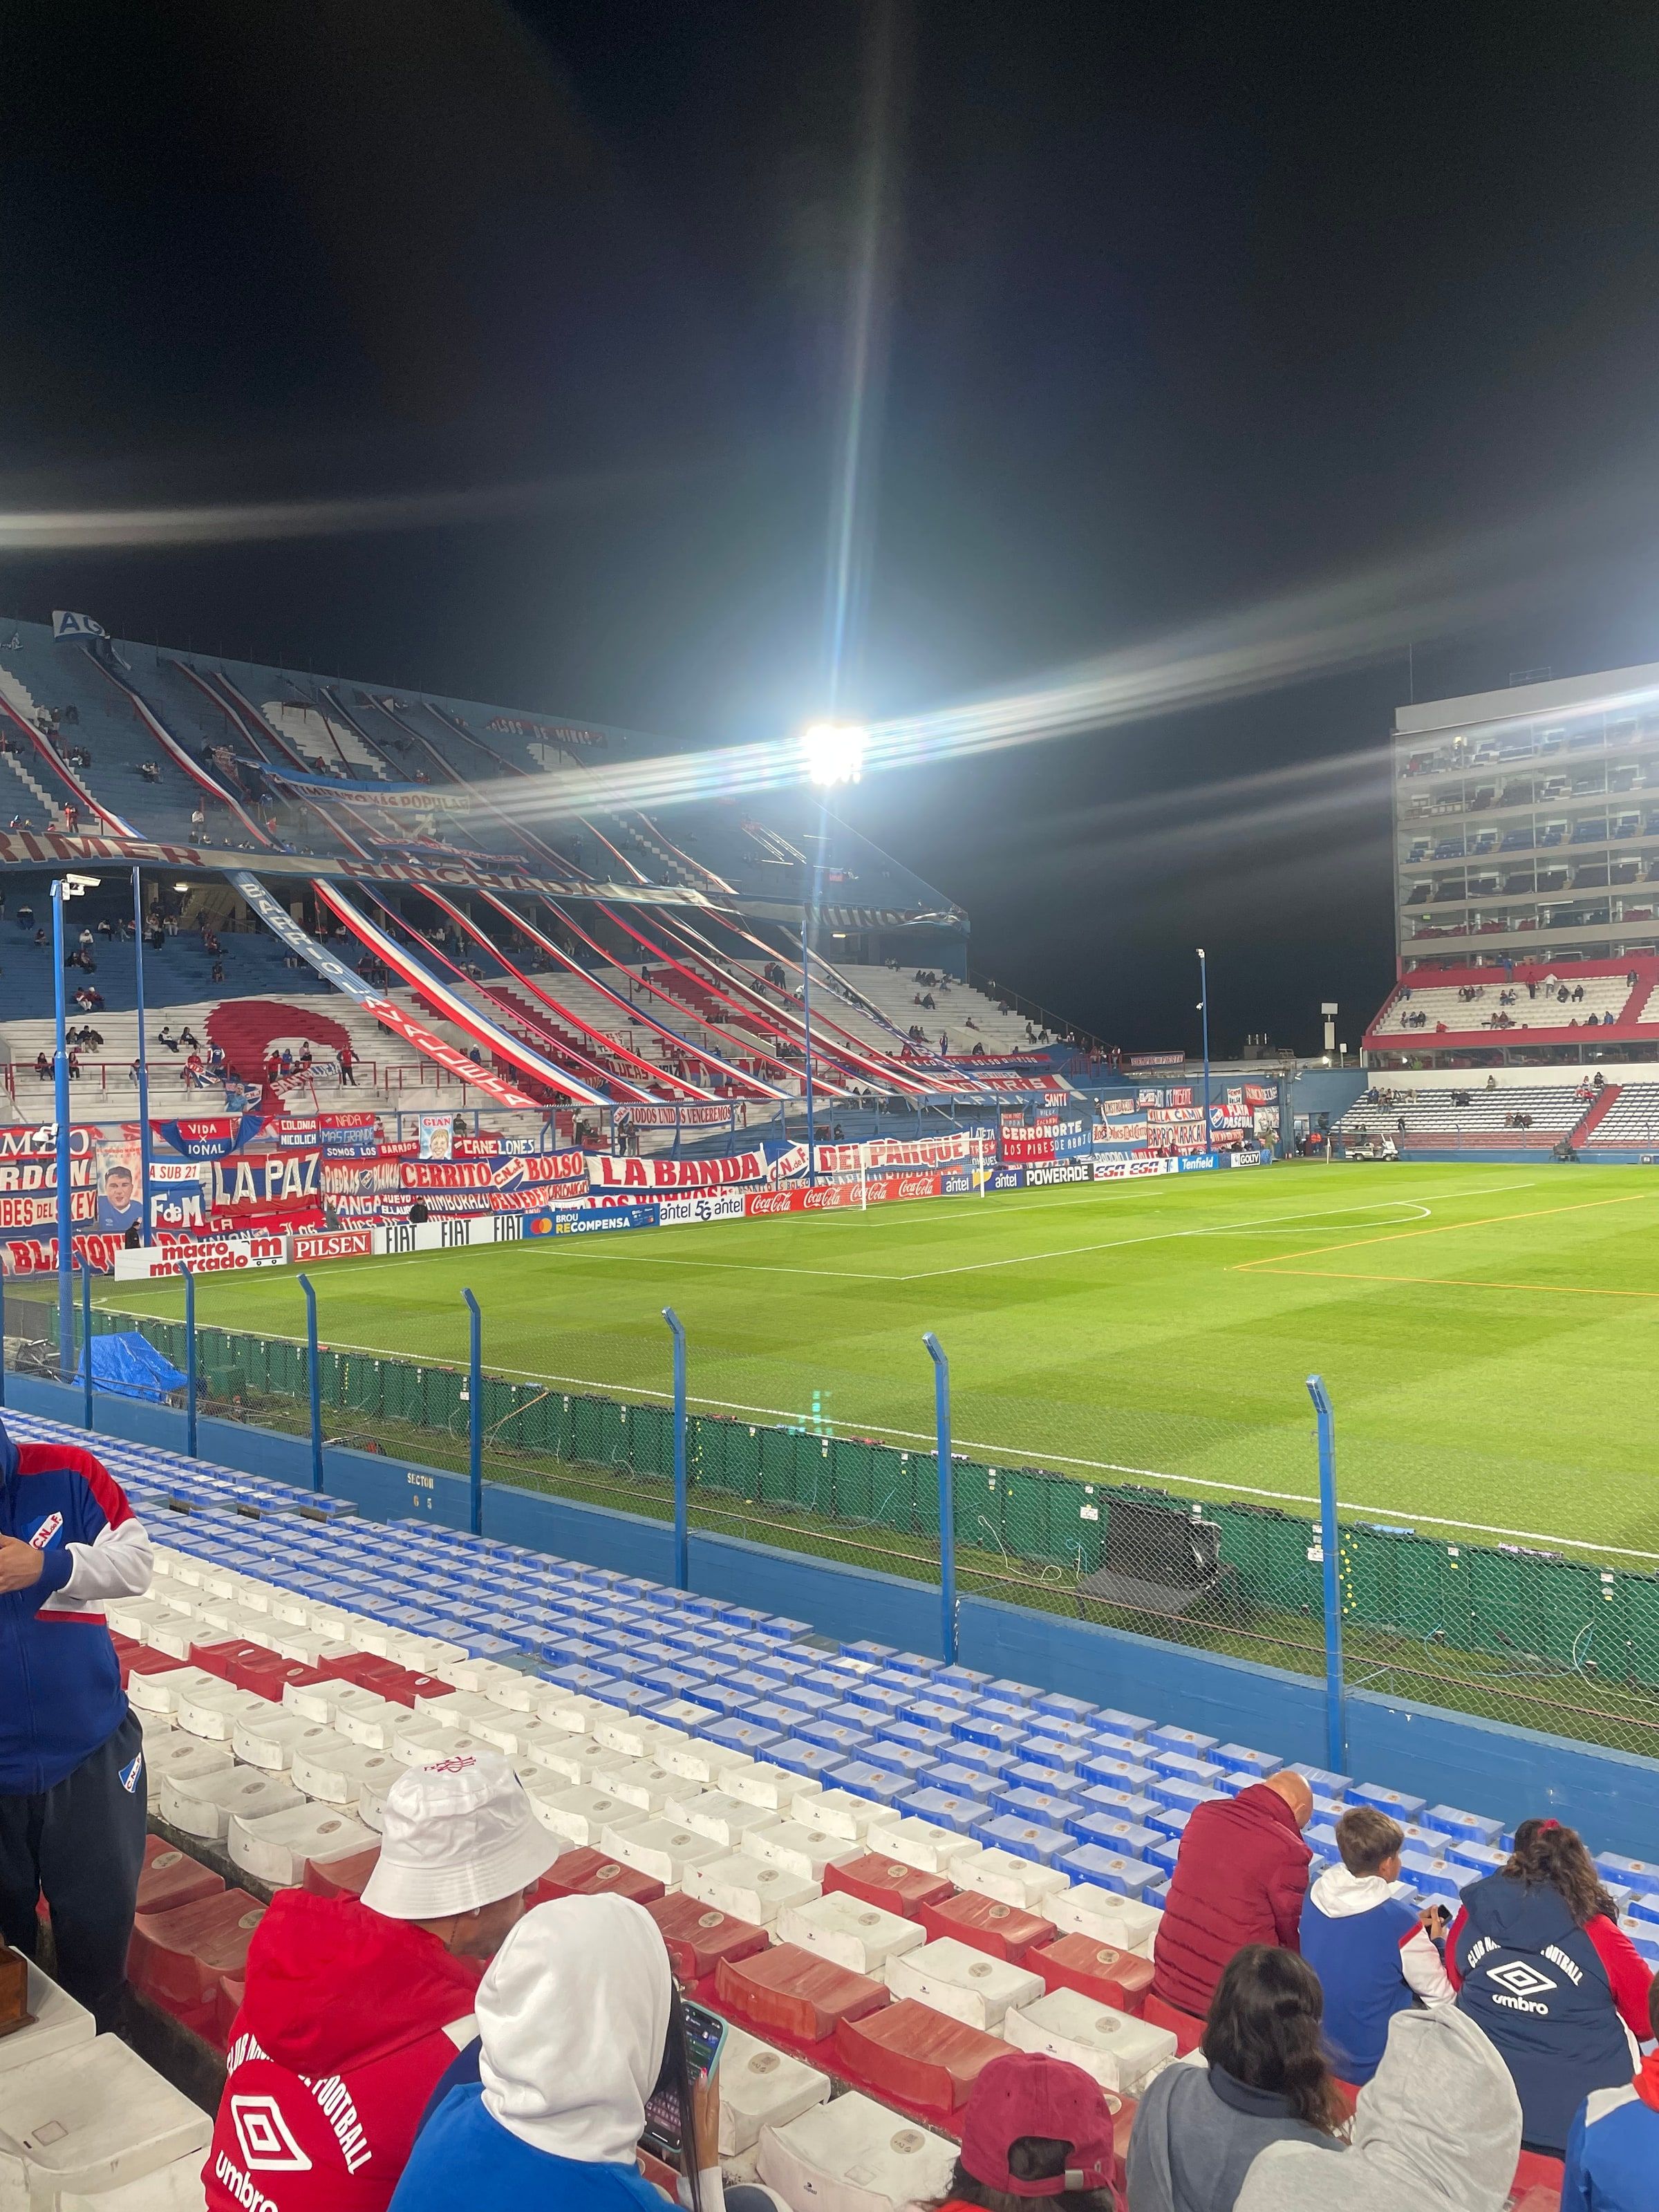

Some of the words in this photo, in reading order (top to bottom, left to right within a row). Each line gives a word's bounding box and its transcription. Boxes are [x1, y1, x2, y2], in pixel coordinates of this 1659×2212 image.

[609, 1060, 648, 1080] LUCAS
[1044, 1093, 1067, 1107] SANTI
[630, 1107, 657, 1123] TODOS
[657, 1107, 686, 1124] UNIDS
[686, 1105, 731, 1124] VENCEREMOS
[1226, 1105, 1250, 1116] PLAYA
[187, 1123, 218, 1135] VIDA
[281, 1120, 317, 1131] COLONIA
[335, 1114, 362, 1127] NADA
[422, 1116, 451, 1127] GIAN
[1222, 1116, 1254, 1129] PASCUAL
[281, 1134, 317, 1145] NICOLICH
[344, 1128, 374, 1143] GRANDE
[1004, 1142, 1022, 1156] LOS
[1027, 1140, 1055, 1156] PIBES
[1055, 1140, 1065, 1151] DE
[1067, 1132, 1091, 1150] ABAJO
[187, 1143, 225, 1156] IONAL
[326, 1147, 355, 1156] SOMOS
[360, 1147, 377, 1156] LOS
[462, 1139, 534, 1155] CANELONES
[869, 1134, 964, 1168] PARQUE
[525, 1151, 583, 1181] BOLSO
[1182, 1156, 1214, 1170] Tenfield
[1240, 1153, 1259, 1164] GOLTV
[160, 1165, 182, 1179] SUB
[185, 1165, 197, 1179] 21
[400, 1162, 492, 1188] CERRITO
[600, 1156, 648, 1187] LA
[653, 1153, 760, 1187] BANDA
[1026, 1165, 1090, 1187] POWERADE
[214, 1161, 258, 1206] LA
[265, 1152, 320, 1202] PAZ
[946, 1177, 969, 1192] antel
[995, 1173, 1018, 1188] antel
[37, 1202, 53, 1219] DEL
[423, 1193, 491, 1211] HIMBORAZO
[660, 1203, 691, 1221] antel
[714, 1197, 743, 1215] antel
[210, 1218, 234, 1232] LA
[556, 1213, 579, 1223] BROU
[556, 1217, 631, 1235] RECOMPENSA
[386, 1224, 418, 1254] FIAT
[441, 1219, 471, 1248] FIAT
[493, 1215, 523, 1243] FIAT
[162, 1242, 229, 1262] macro
[295, 1234, 367, 1259] PILSEN
[149, 1251, 248, 1277] mercado
[427, 1497, 432, 1510] 5
[1467, 1940, 1485, 1969] CLUB
[1540, 1944, 1584, 1987] OOTBALL
[1492, 1994, 1550, 2016] umbro
[215, 2149, 279, 2212] umbro
